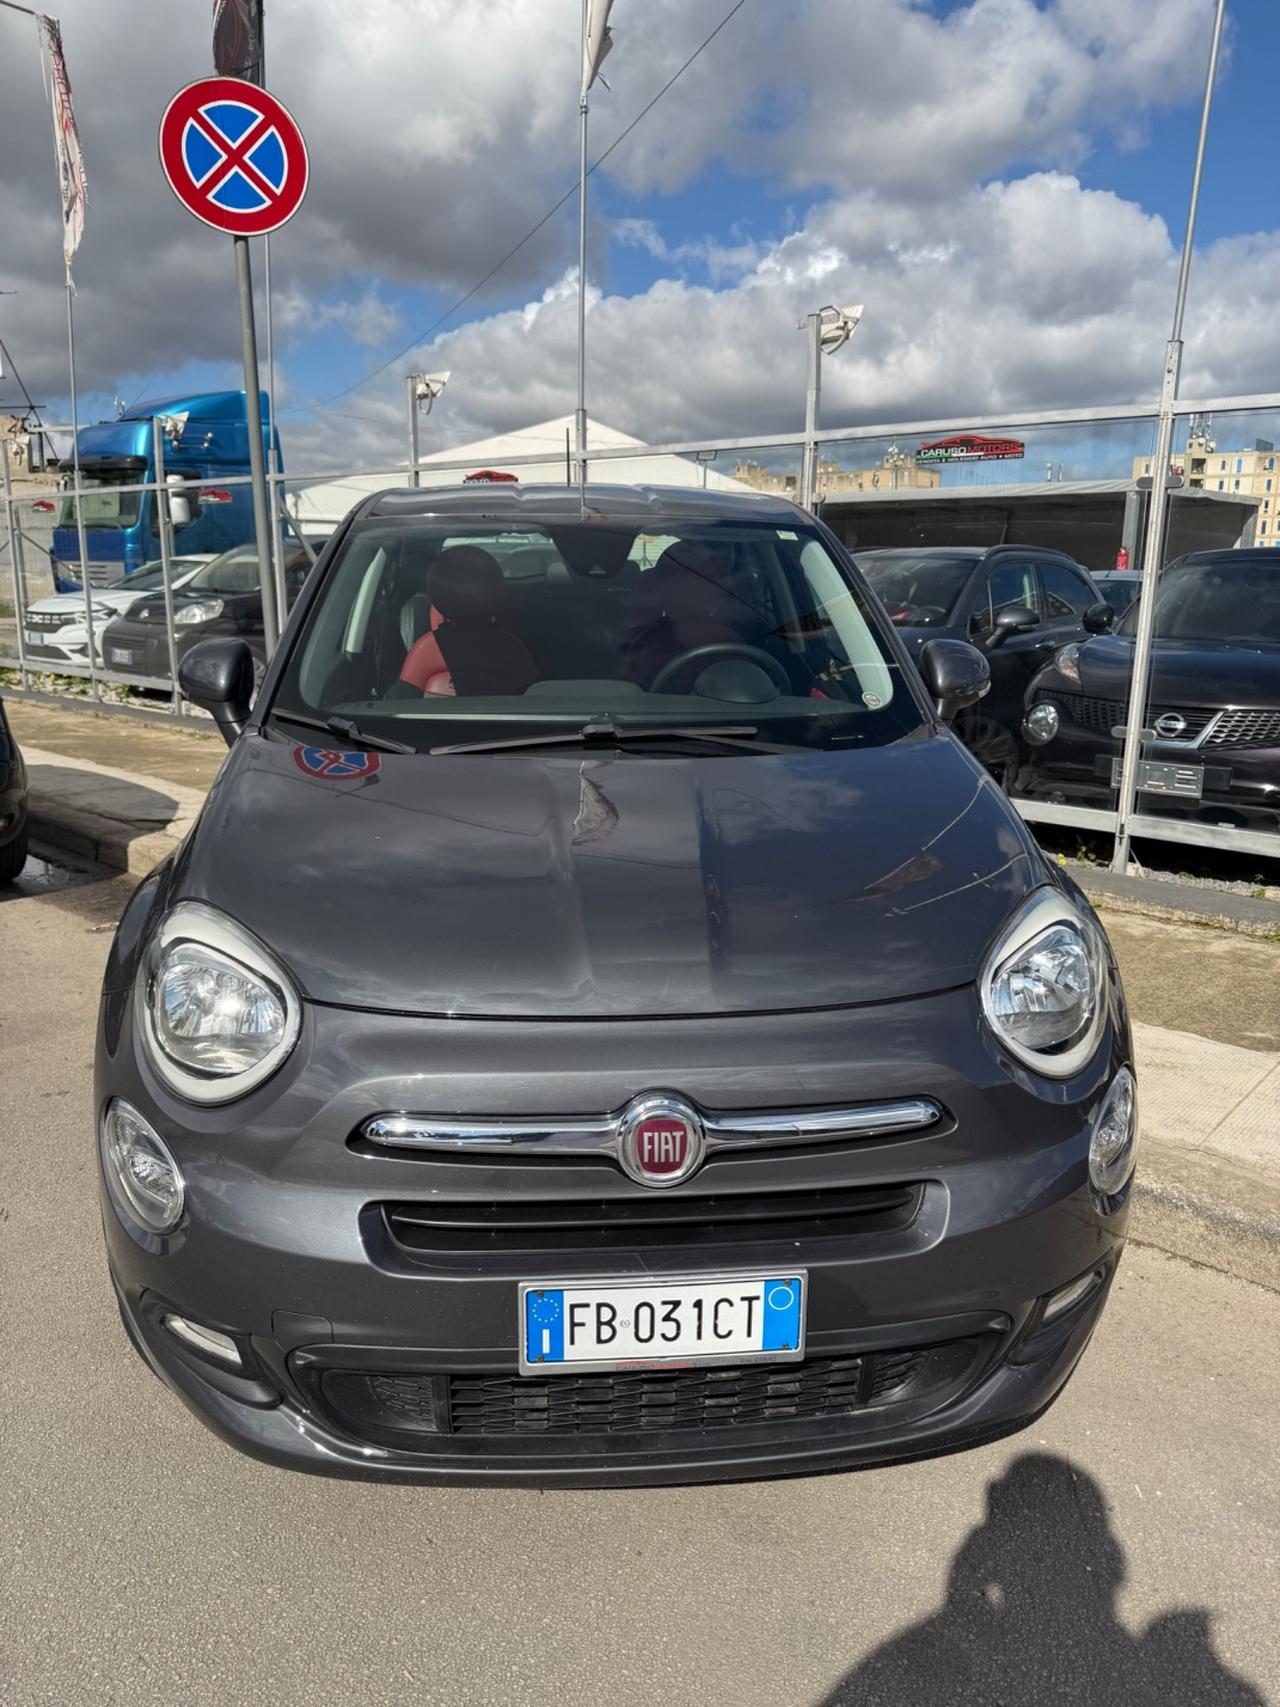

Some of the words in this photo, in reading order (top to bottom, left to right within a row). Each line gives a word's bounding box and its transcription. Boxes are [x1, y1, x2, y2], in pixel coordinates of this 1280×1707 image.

[920, 446, 967, 458] CARUSO
[967, 443, 1018, 455] MOTORS
[643, 1131, 684, 1163] FIAT
[569, 1302, 618, 1346] FB
[634, 1295, 761, 1343] 031CT
